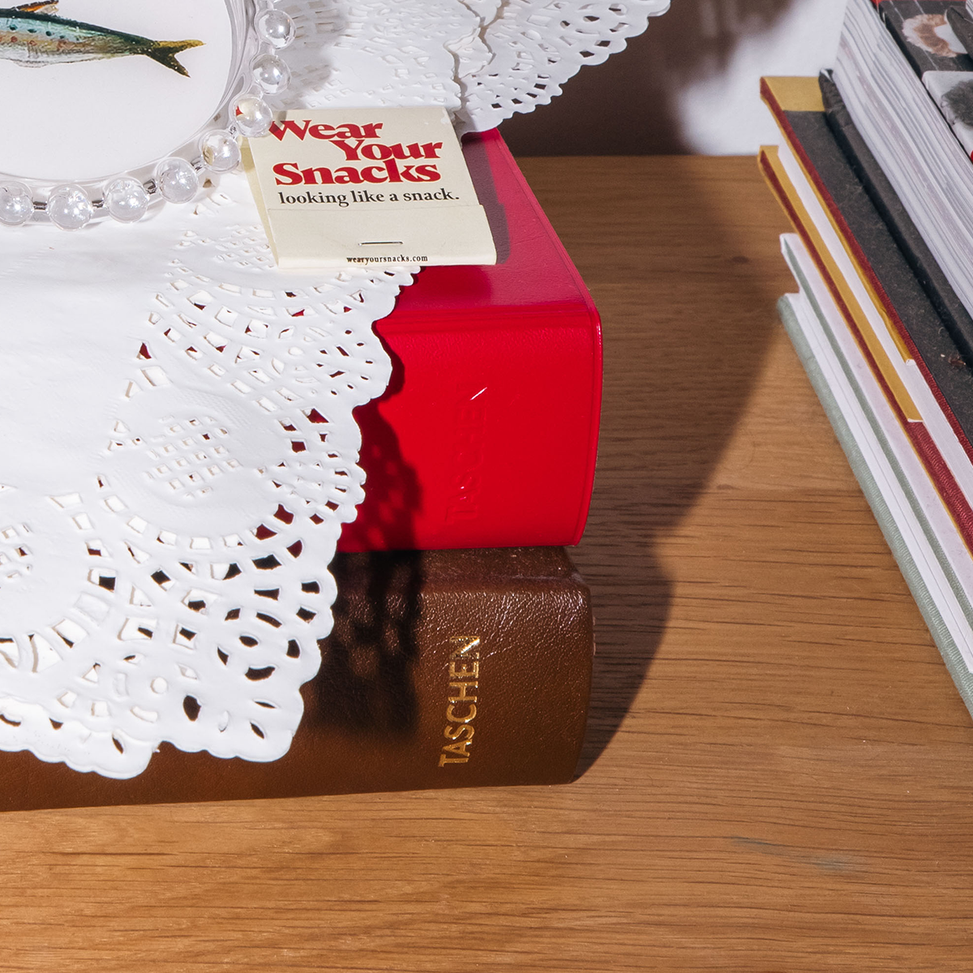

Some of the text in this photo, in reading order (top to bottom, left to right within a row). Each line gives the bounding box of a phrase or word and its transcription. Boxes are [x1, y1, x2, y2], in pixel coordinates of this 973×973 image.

[268, 120, 383, 141] Wear
[329, 139, 443, 161] Your
[272, 158, 442, 185] Snacks
[278, 188, 460, 207] looking like a snack.
[346, 254, 429, 266] wearyoursnacks.com
[445, 381, 487, 525] TASCHEN
[438, 635, 480, 767] TASCHEN
